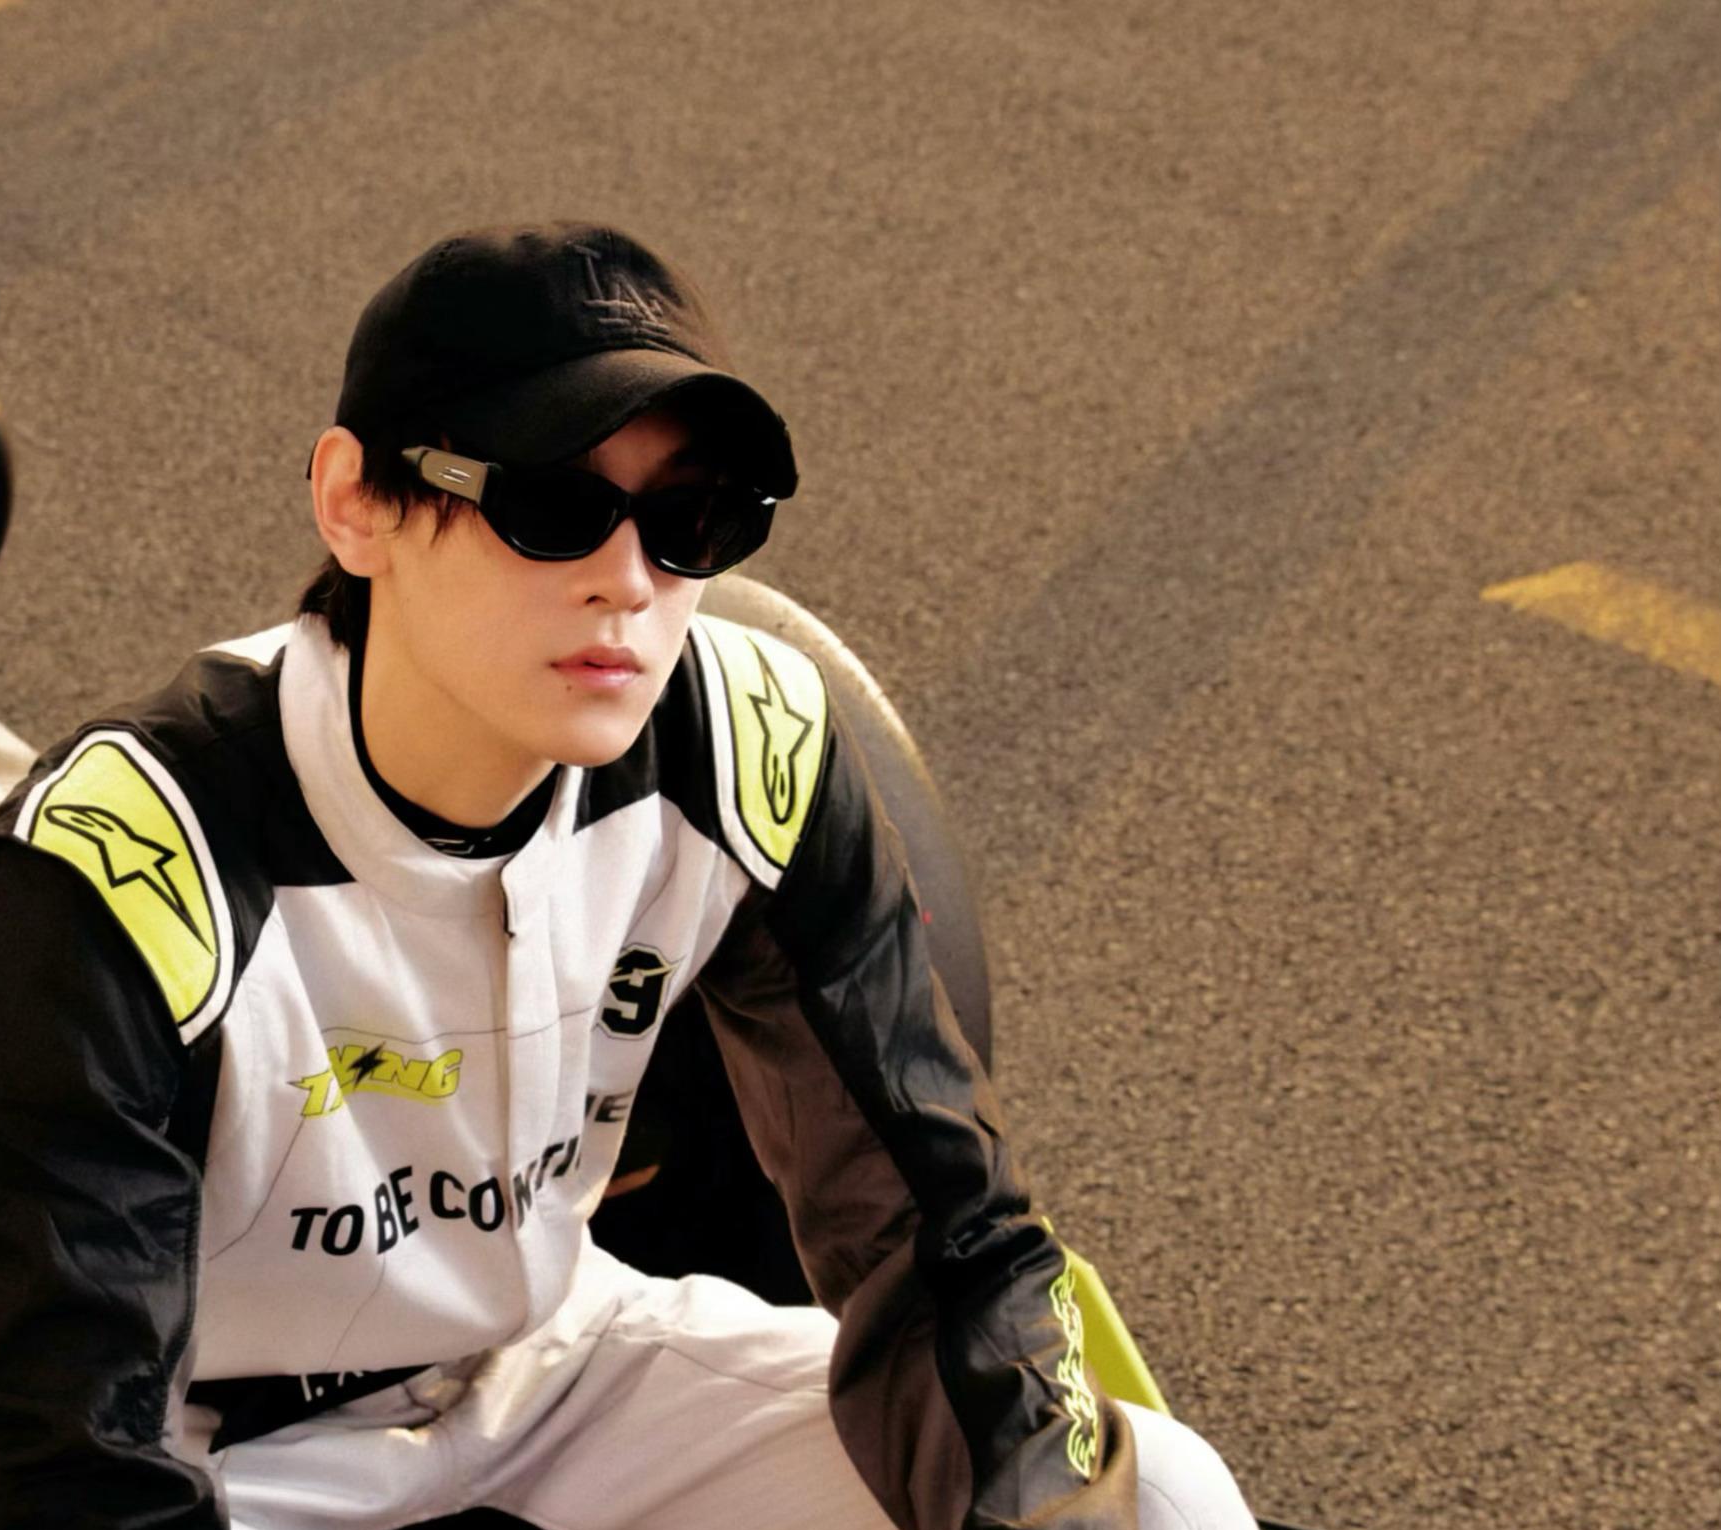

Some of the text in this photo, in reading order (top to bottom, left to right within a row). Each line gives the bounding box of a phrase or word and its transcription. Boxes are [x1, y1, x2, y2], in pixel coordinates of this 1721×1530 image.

[569, 241, 670, 336] LA
[598, 944, 671, 1040] 9
[290, 1204, 365, 1257] TO
[375, 1166, 419, 1254] BE
